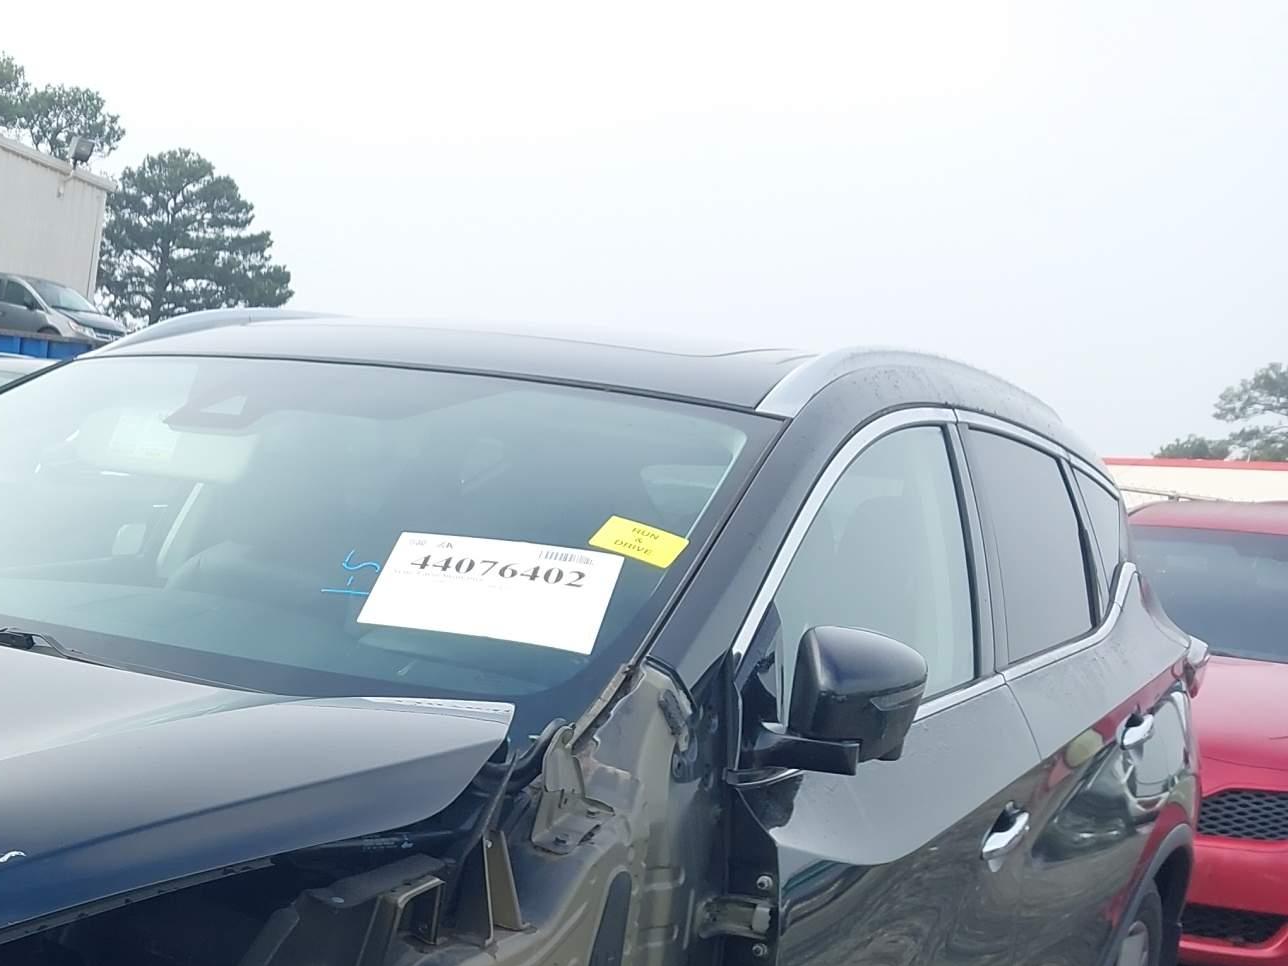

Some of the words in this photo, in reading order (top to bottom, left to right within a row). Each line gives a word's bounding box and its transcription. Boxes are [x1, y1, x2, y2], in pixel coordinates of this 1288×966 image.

[632, 527, 659, 541] RUN
[614, 539, 652, 556] DRIVE
[410, 554, 587, 588] 44076402
